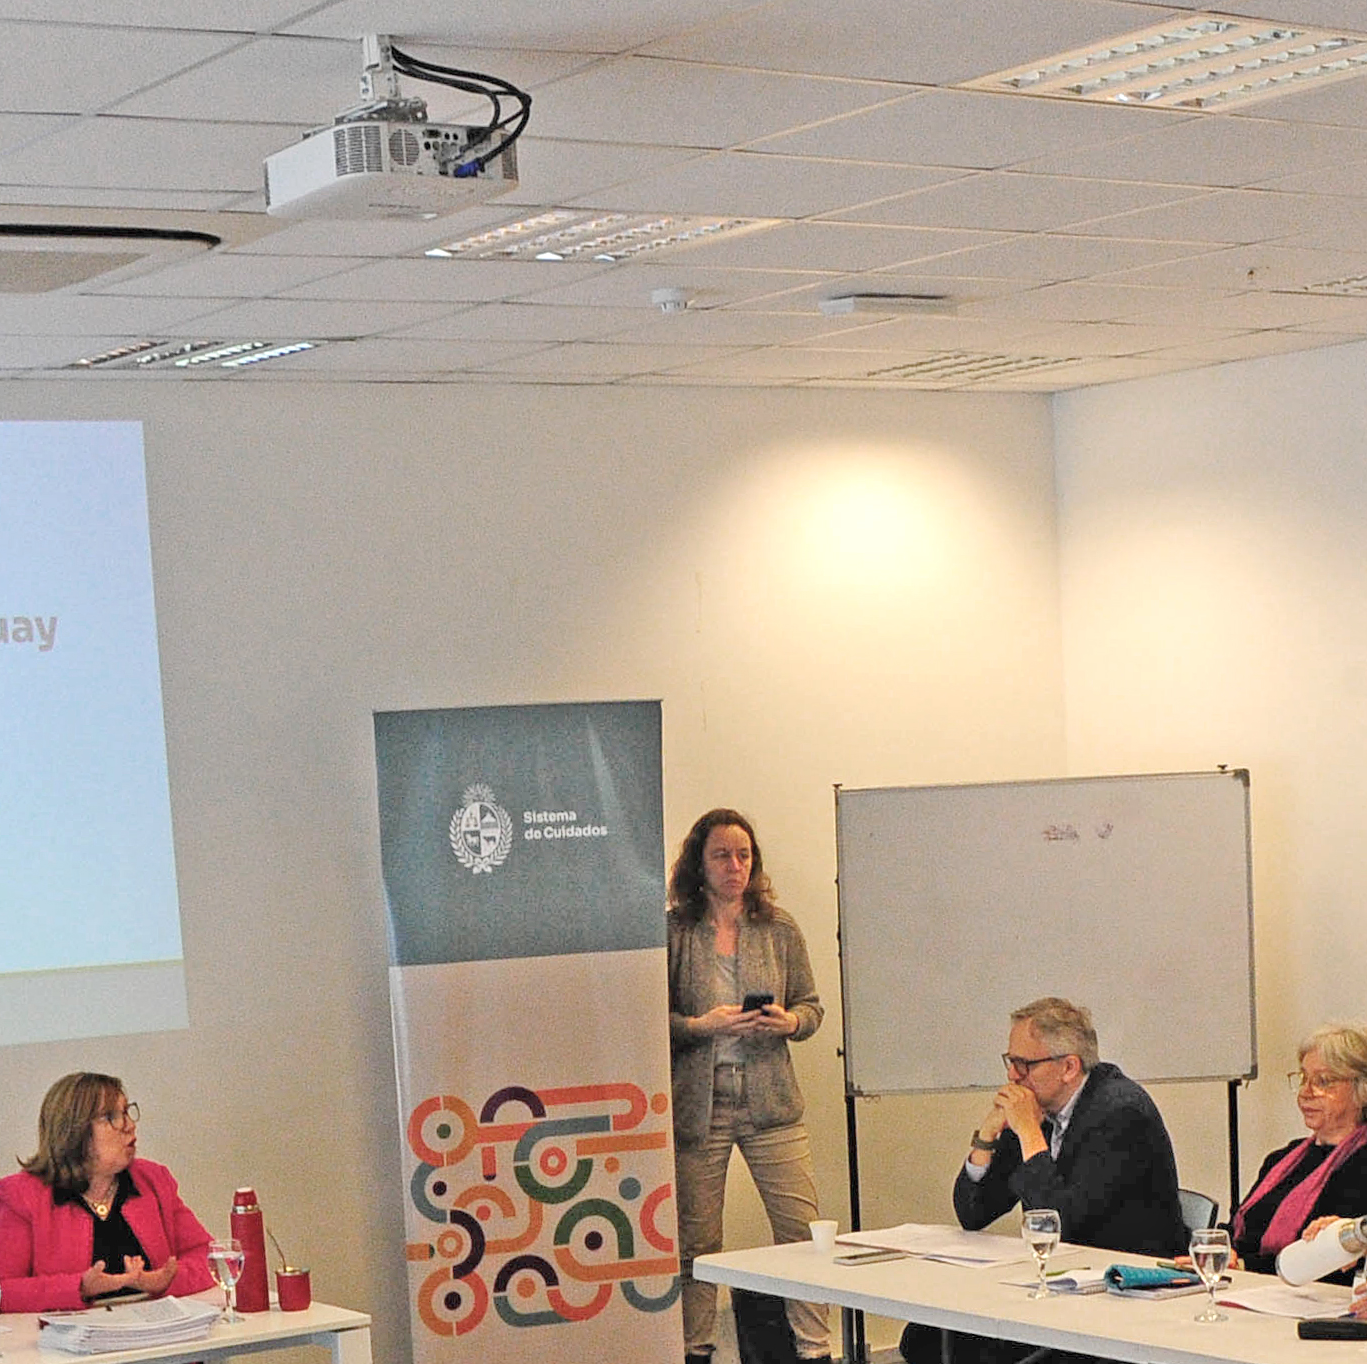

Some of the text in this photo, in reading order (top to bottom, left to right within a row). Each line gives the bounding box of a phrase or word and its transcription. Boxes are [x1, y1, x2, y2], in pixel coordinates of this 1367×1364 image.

[523, 810, 577, 824] Sistema
[524, 824, 608, 840] de Cuidados
